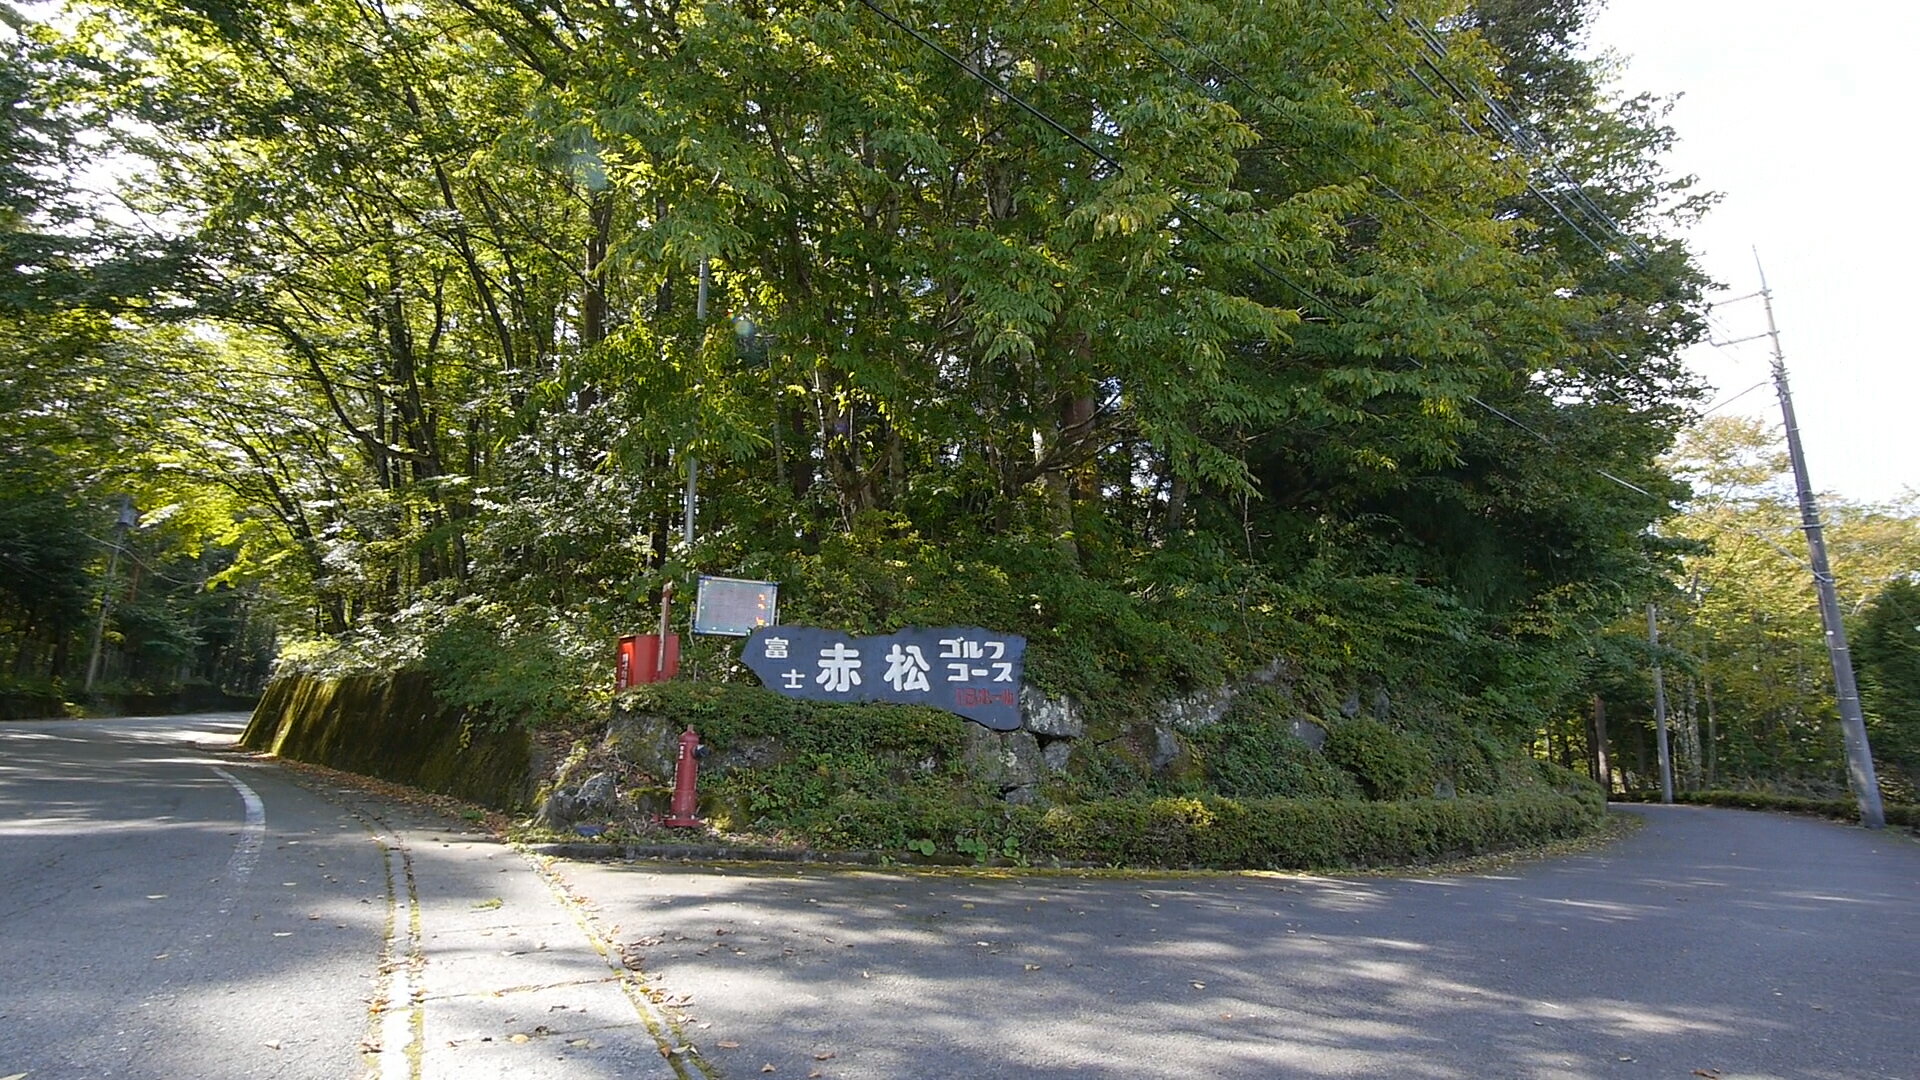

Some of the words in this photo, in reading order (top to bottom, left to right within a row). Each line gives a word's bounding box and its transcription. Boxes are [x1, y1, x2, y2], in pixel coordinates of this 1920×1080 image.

[938, 636, 1005, 659] ゴルフ
[764, 636, 806, 689] 富士
[816, 642, 931, 692] 赤松
[947, 662, 1013, 682] コース
